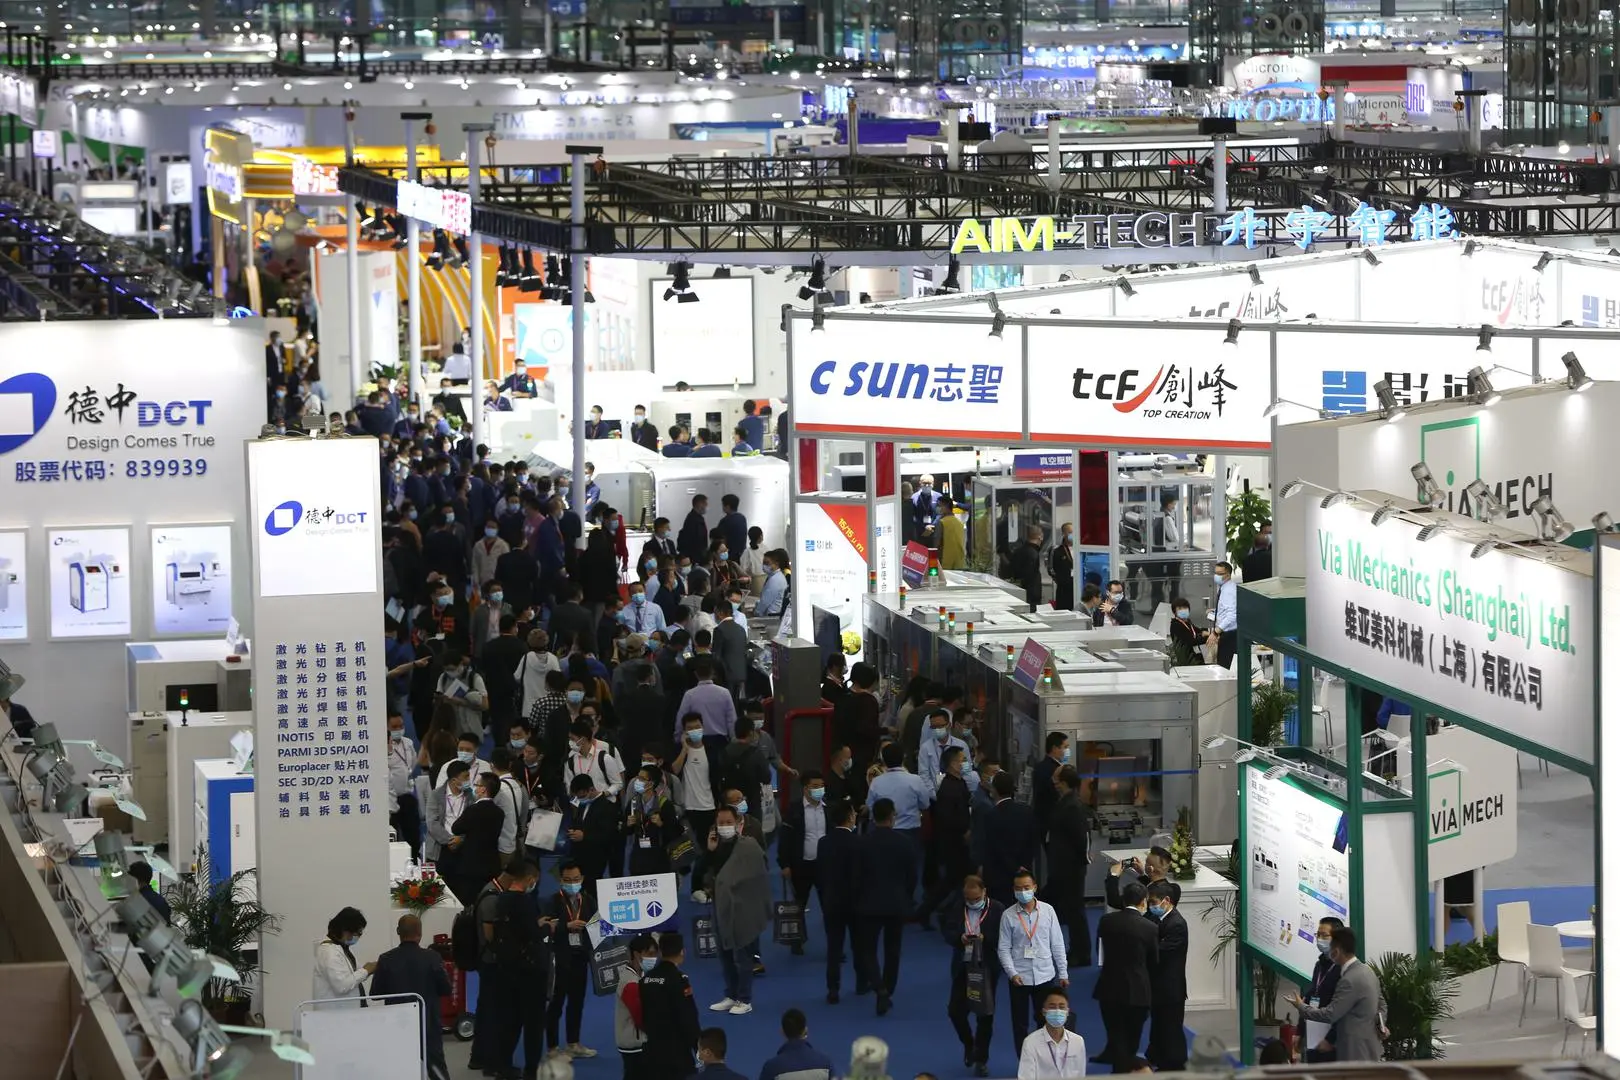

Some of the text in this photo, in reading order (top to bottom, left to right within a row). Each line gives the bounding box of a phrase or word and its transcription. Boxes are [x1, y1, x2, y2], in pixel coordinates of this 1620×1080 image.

[950, 202, 1459, 254] AIM-TECH 升宇智能
[929, 363, 1004, 404] 志聖
[137, 400, 213, 428] DCT
[1142, 409, 1212, 420] TOP CREATION
[67, 433, 216, 452] Design Comes True
[126, 458, 207, 478] 839939
[335, 512, 368, 525] DCT
[1318, 528, 1576, 656] Via Mechanics (Shanghai) Ltd.
[276, 641, 366, 655] 激光钻孔机
[276, 656, 367, 670] 激光切割机
[276, 671, 367, 685] 激光分板机
[277, 685, 367, 700] 激光打标机
[277, 700, 368, 714] 激光焊锡机
[278, 715, 368, 729] 高速点胶机
[277, 729, 370, 743] INOTIS 印刷机
[278, 745, 369, 757] PARMI 3D SPI/AOI
[278, 759, 370, 774] Europlacer 贴片机
[278, 774, 370, 787] SEC 3D/2D X-RAY
[278, 789, 370, 803] 辅料贴装机
[279, 803, 371, 818] 治具拆装机
[1463, 793, 1503, 827] MECH
[616, 878, 658, 891] 请继续参观
